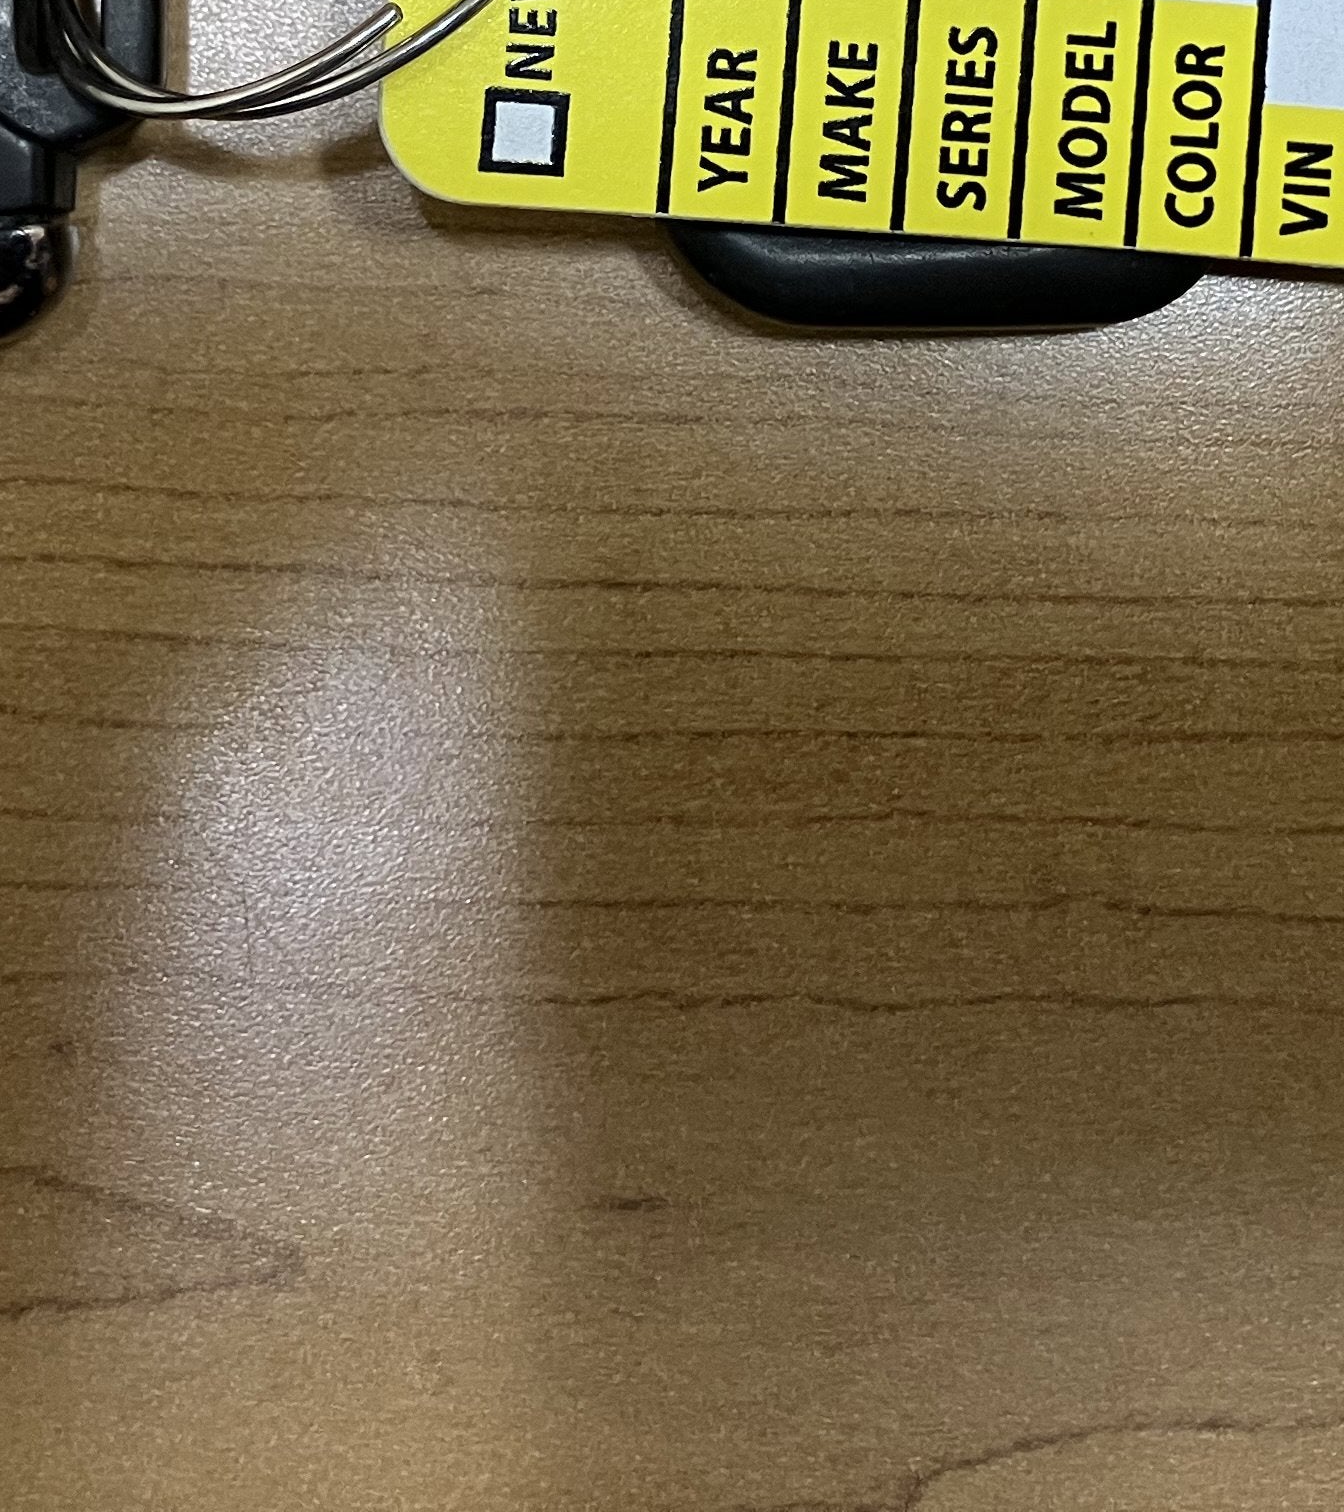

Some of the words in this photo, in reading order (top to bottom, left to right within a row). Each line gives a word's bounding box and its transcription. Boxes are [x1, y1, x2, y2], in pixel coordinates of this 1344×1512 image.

[697, 45, 759, 193] YEAR
[818, 40, 881, 203] MAKE
[937, 25, 1000, 213] SERIES
[1055, 19, 1118, 222] MODEL
[1164, 41, 1227, 230] COLOR
[1278, 138, 1336, 238] VIN
